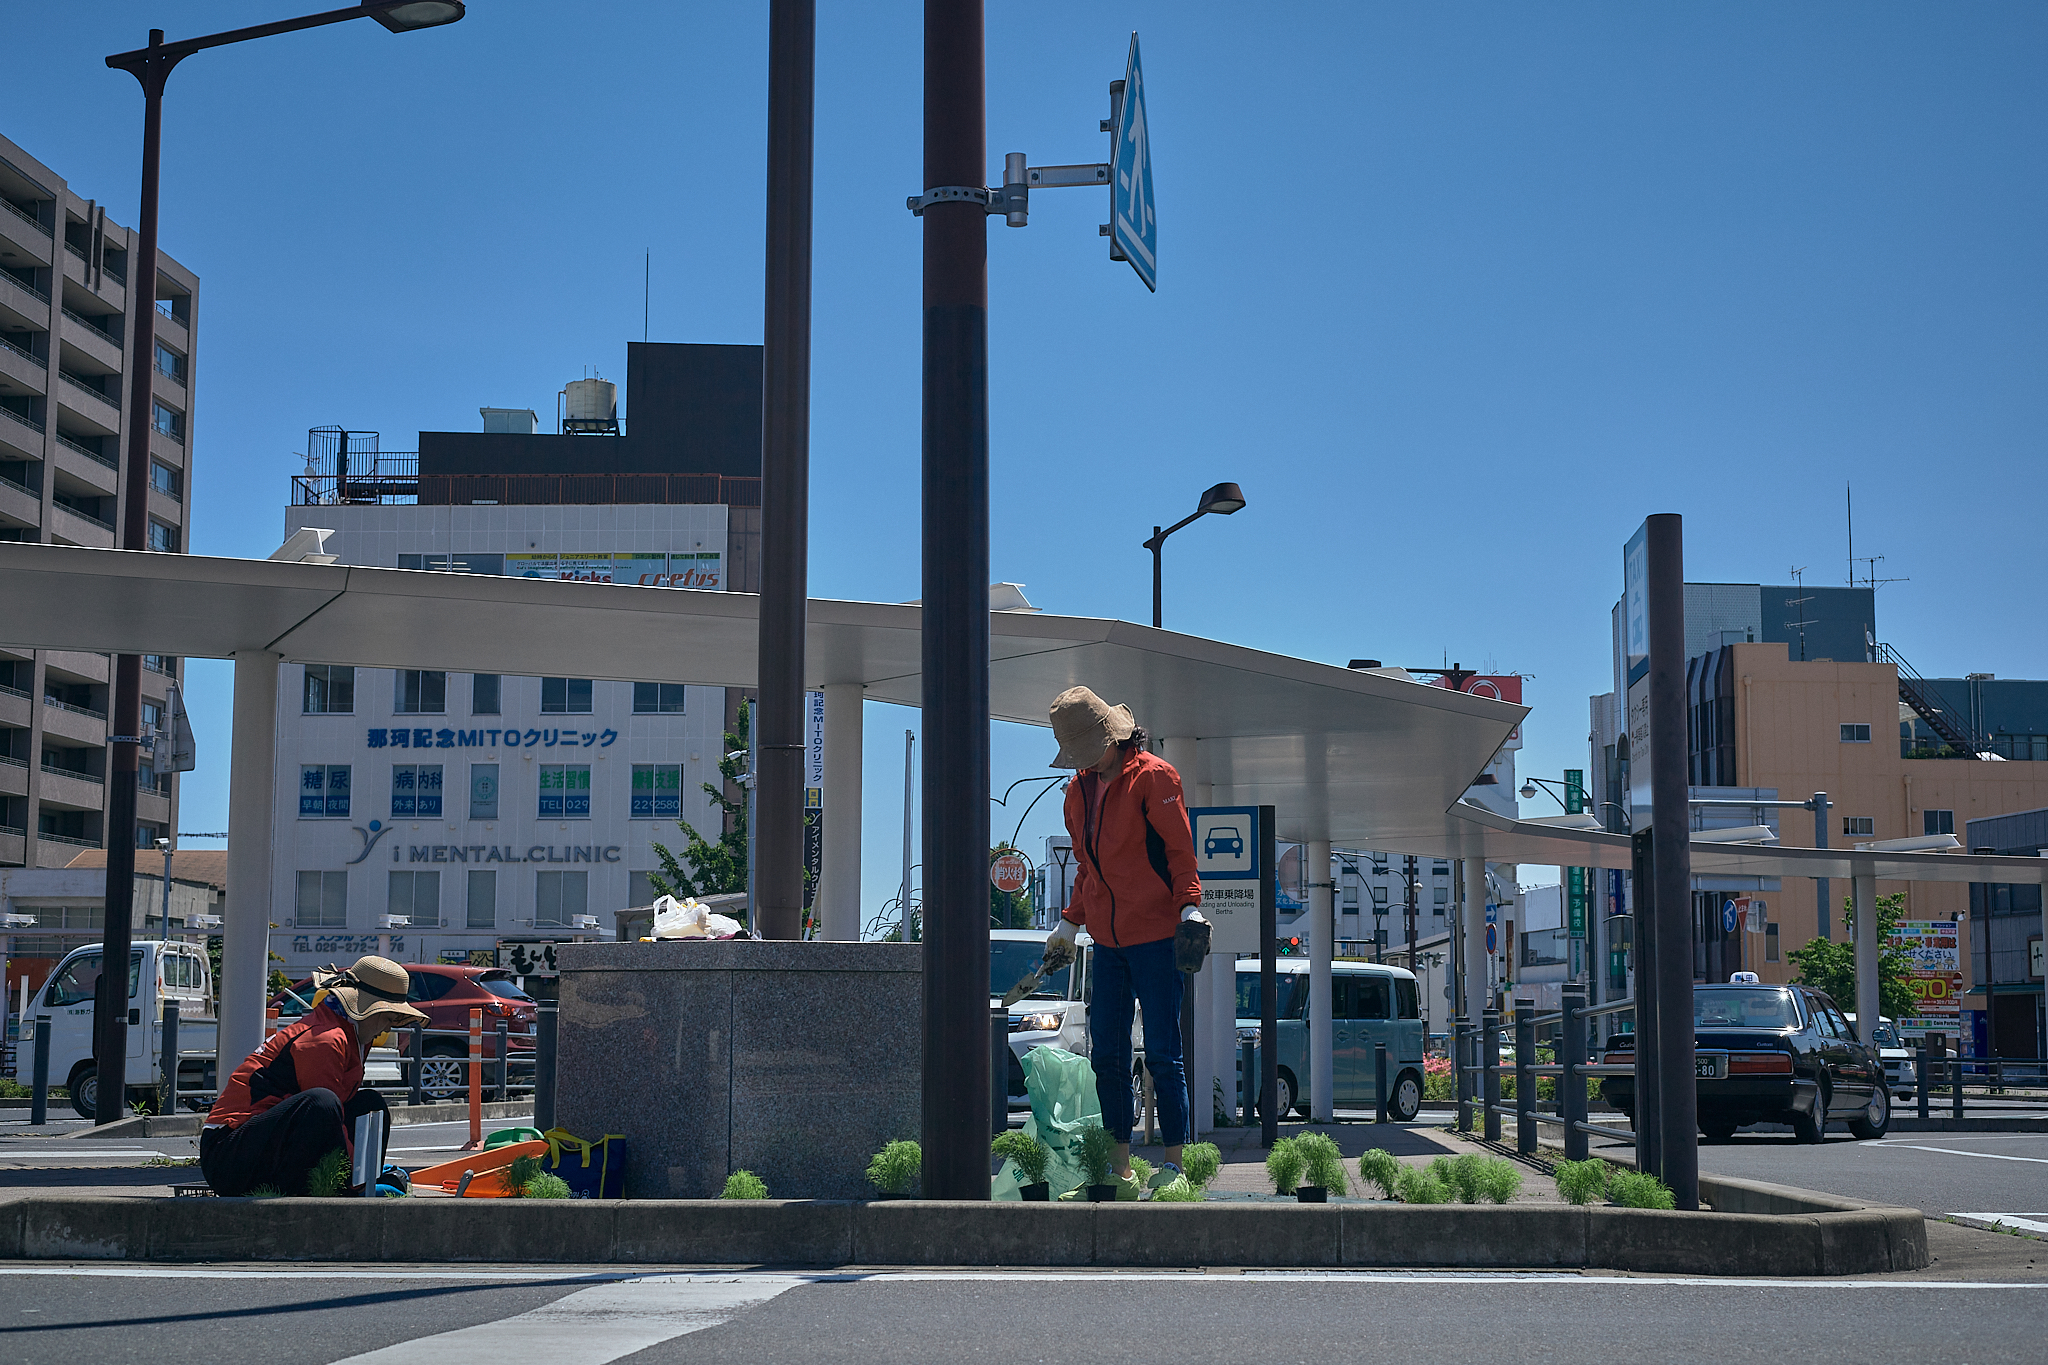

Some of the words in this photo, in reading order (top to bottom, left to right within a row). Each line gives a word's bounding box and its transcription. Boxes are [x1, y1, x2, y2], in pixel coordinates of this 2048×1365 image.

[1629, 549, 1643, 589] TAXI
[367, 728, 618, 748] 那珂記念MITOクリニック
[542, 800, 562, 810] TEL
[995, 866, 1023, 880] 消火栓
[1228, 901, 1255, 909] Unloading
[292, 942, 312, 952] TEL
